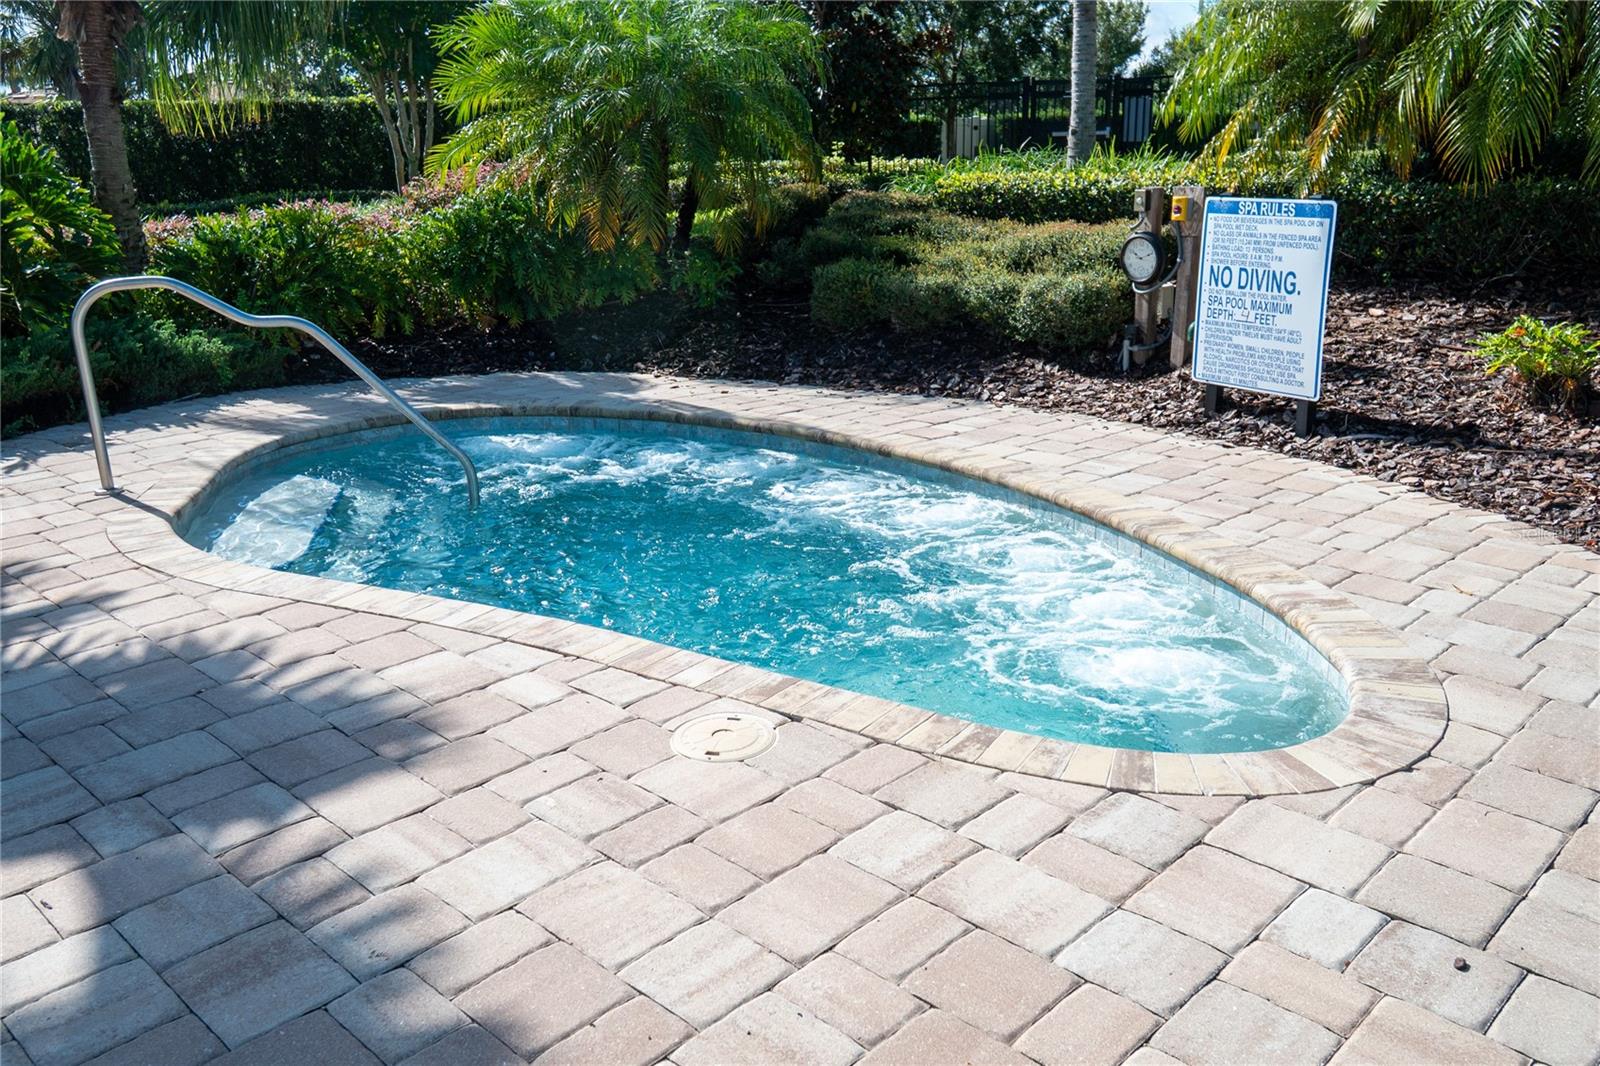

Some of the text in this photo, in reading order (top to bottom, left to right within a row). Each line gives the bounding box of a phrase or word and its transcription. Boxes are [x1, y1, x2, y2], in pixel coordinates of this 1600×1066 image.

[1238, 201, 1296, 216] SPA RULES
[1208, 264, 1302, 295] NO DIVING.
[1207, 294, 1292, 314] SPA POOL MAXIMUM
[1205, 319, 1224, 327] MAXIMUM
[1240, 309, 1250, 322] 4
[1254, 312, 1278, 326] FEET.
[1204, 326, 1225, 334] CHILDREN
[1203, 339, 1226, 348] PREGNANT
[1285, 350, 1304, 359] PEOPLE
[1232, 350, 1256, 359] PROBLEMS
[1266, 355, 1285, 363] PEOPLE
[1218, 361, 1246, 371] DROWSINESS
[1247, 366, 1265, 374] SHOULD
[1225, 356, 1249, 365] NARCOTICS
[1274, 363, 1291, 371] DRUGS
[1201, 372, 1221, 380] MAXIMUM
[1217, 368, 1236, 377] WITHOUT
[1250, 373, 1279, 383] CONSULTING
